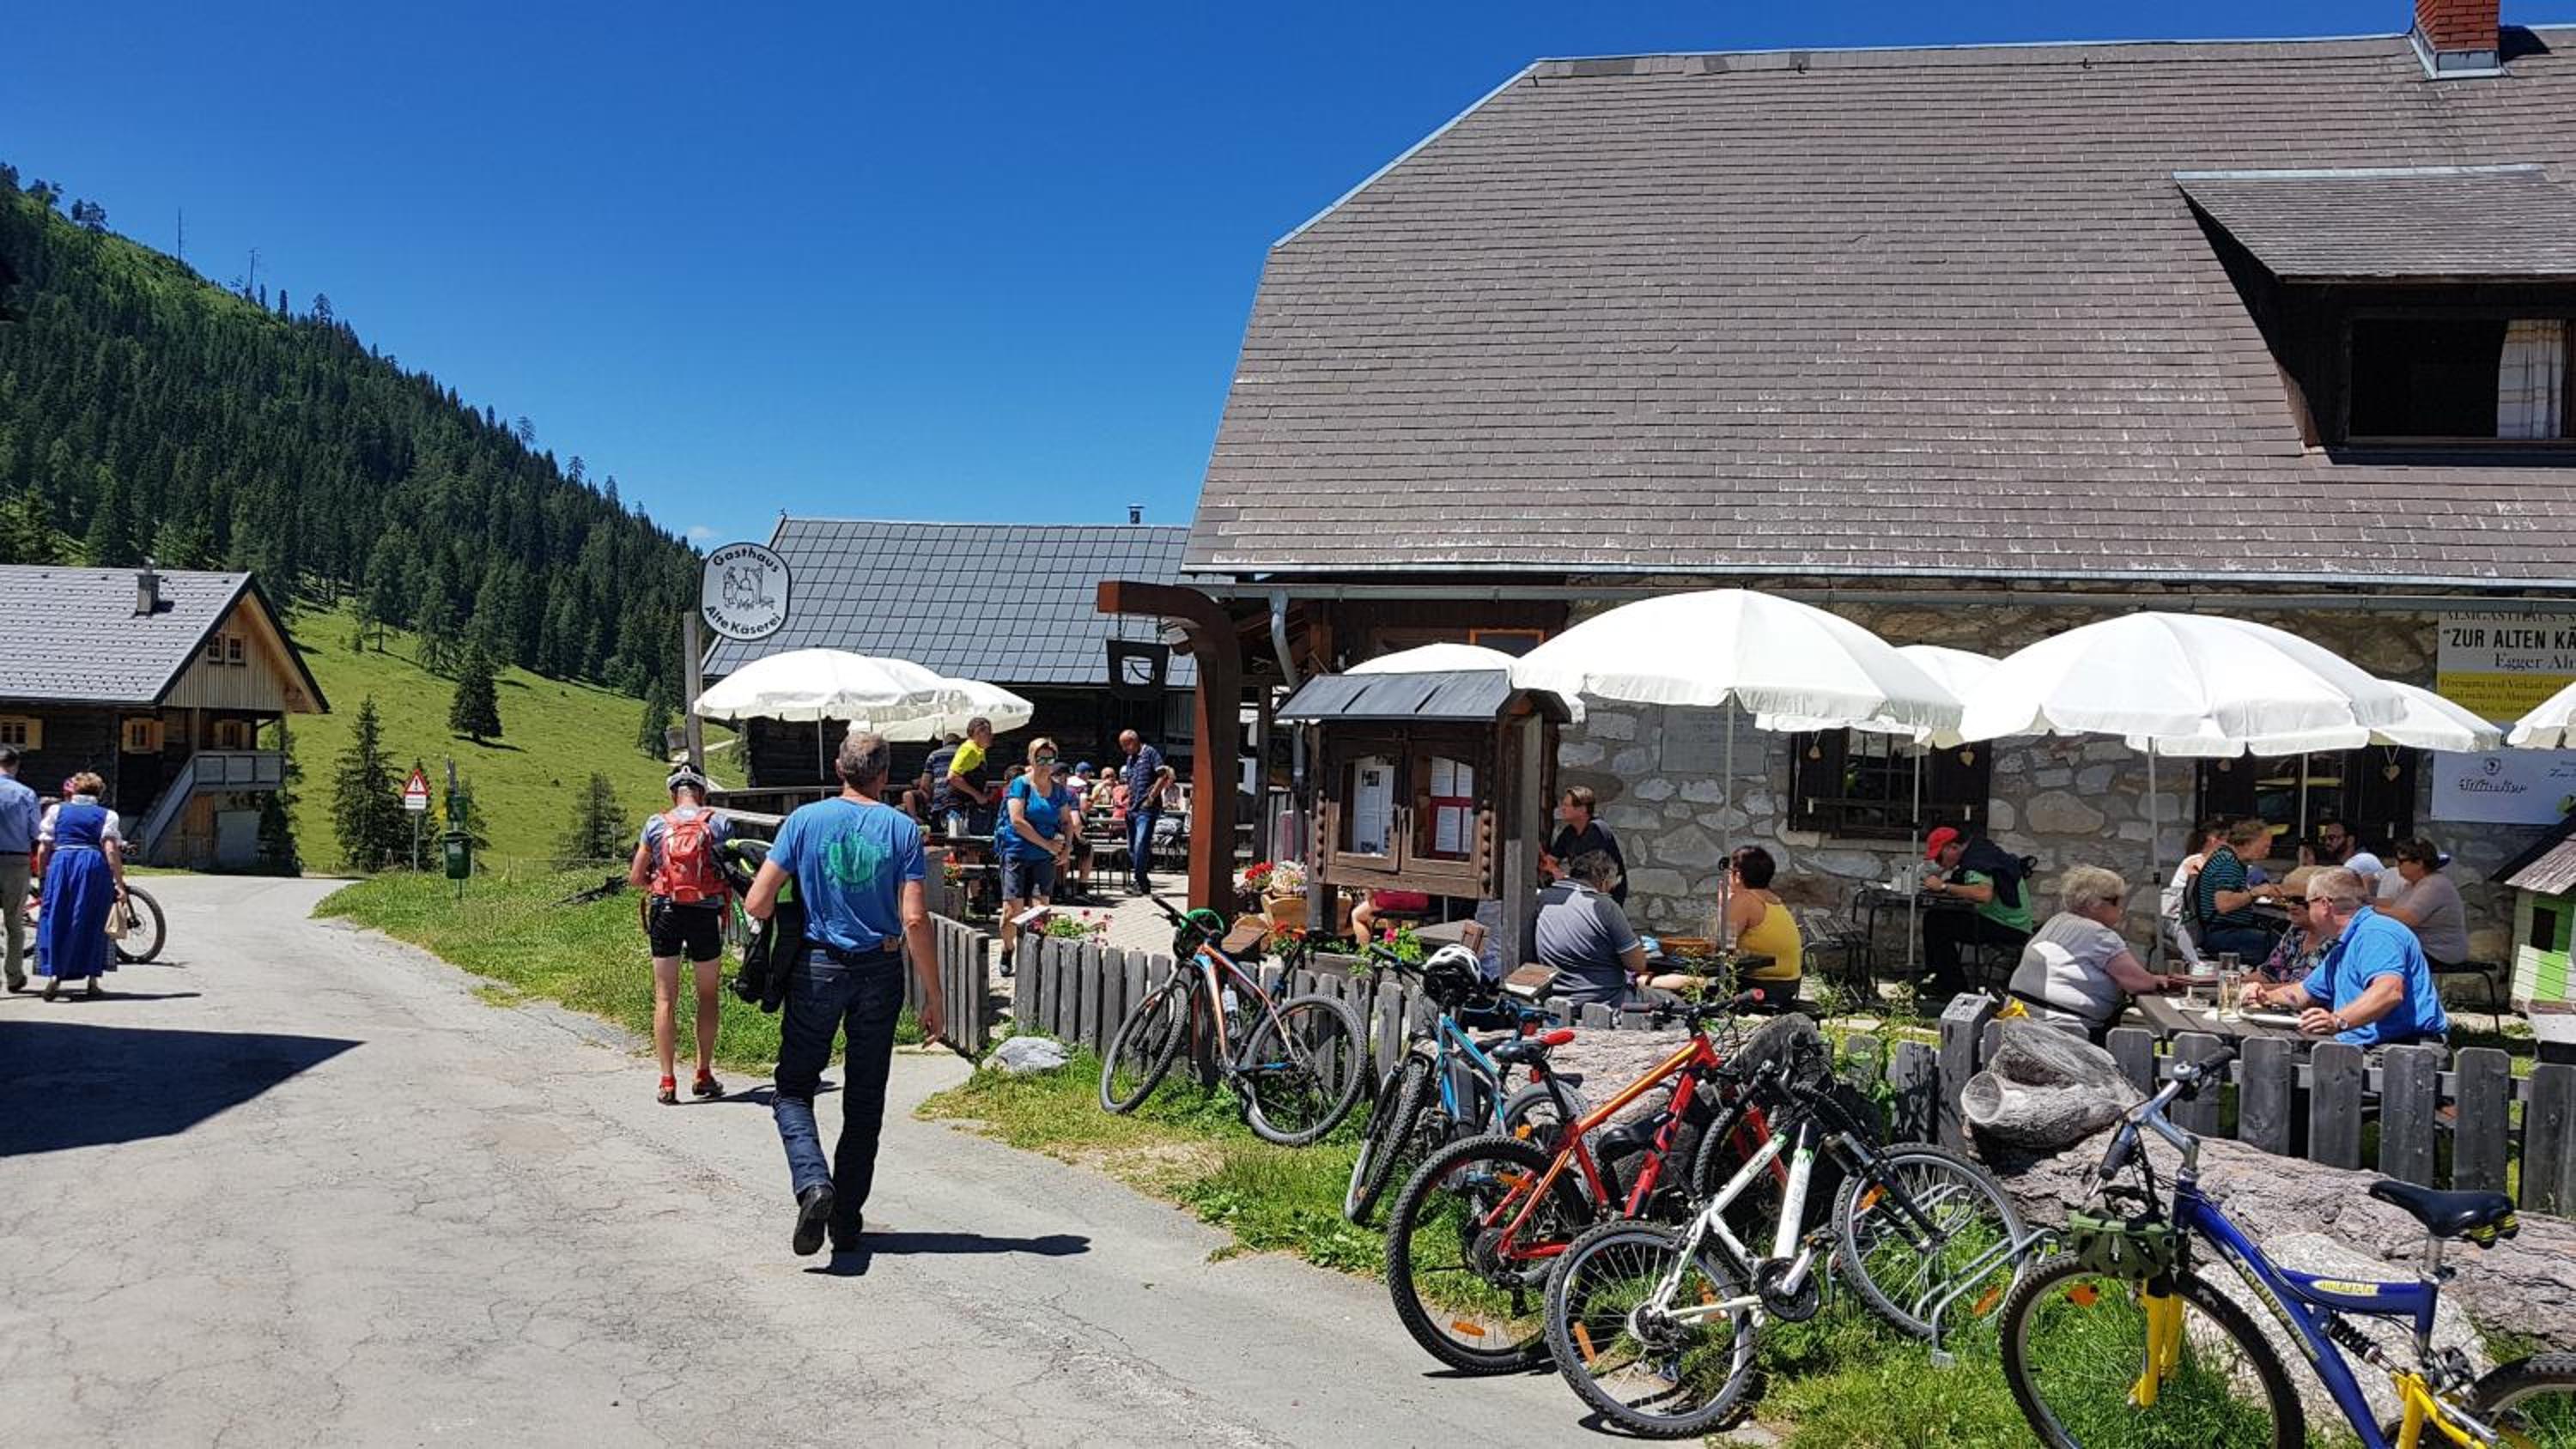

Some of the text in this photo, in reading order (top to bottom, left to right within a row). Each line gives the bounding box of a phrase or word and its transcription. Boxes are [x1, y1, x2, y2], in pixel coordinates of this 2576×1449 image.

[714, 547, 781, 573] Gasthaus
[705, 605, 729, 629] Alte
[2493, 628, 2546, 649] ALTEN
[2494, 652, 2543, 672] Egger
